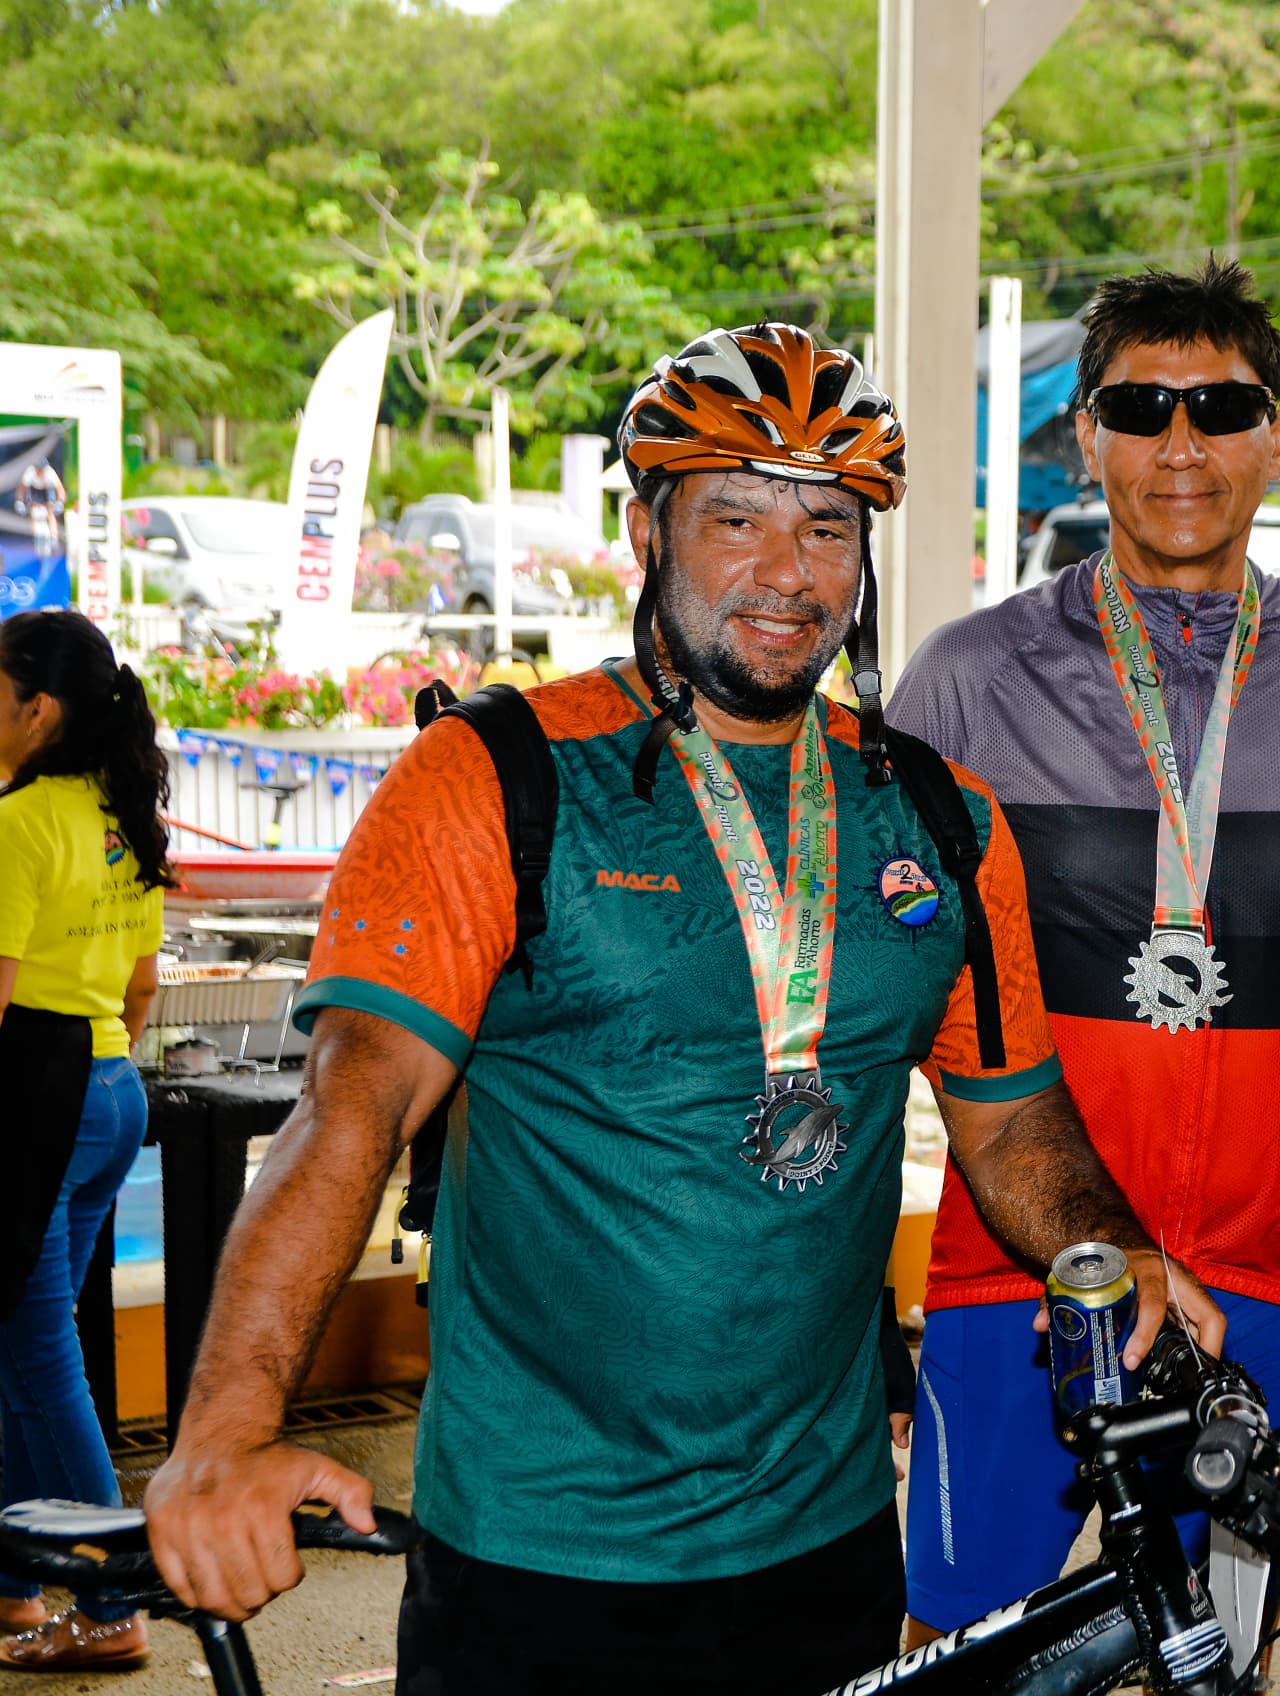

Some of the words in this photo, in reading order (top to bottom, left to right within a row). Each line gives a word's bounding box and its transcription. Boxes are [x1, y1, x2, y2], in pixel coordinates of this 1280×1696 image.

[297, 458, 343, 602] CEMPLUS
[88, 492, 109, 622] CEMPLUS
[597, 870, 681, 893] MACA
[736, 860, 776, 930] 2022
[900, 864, 912, 879] 2
[795, 908, 812, 968] Farmacias
[807, 920, 820, 963] Ahorro
[786, 968, 818, 1006] FA
